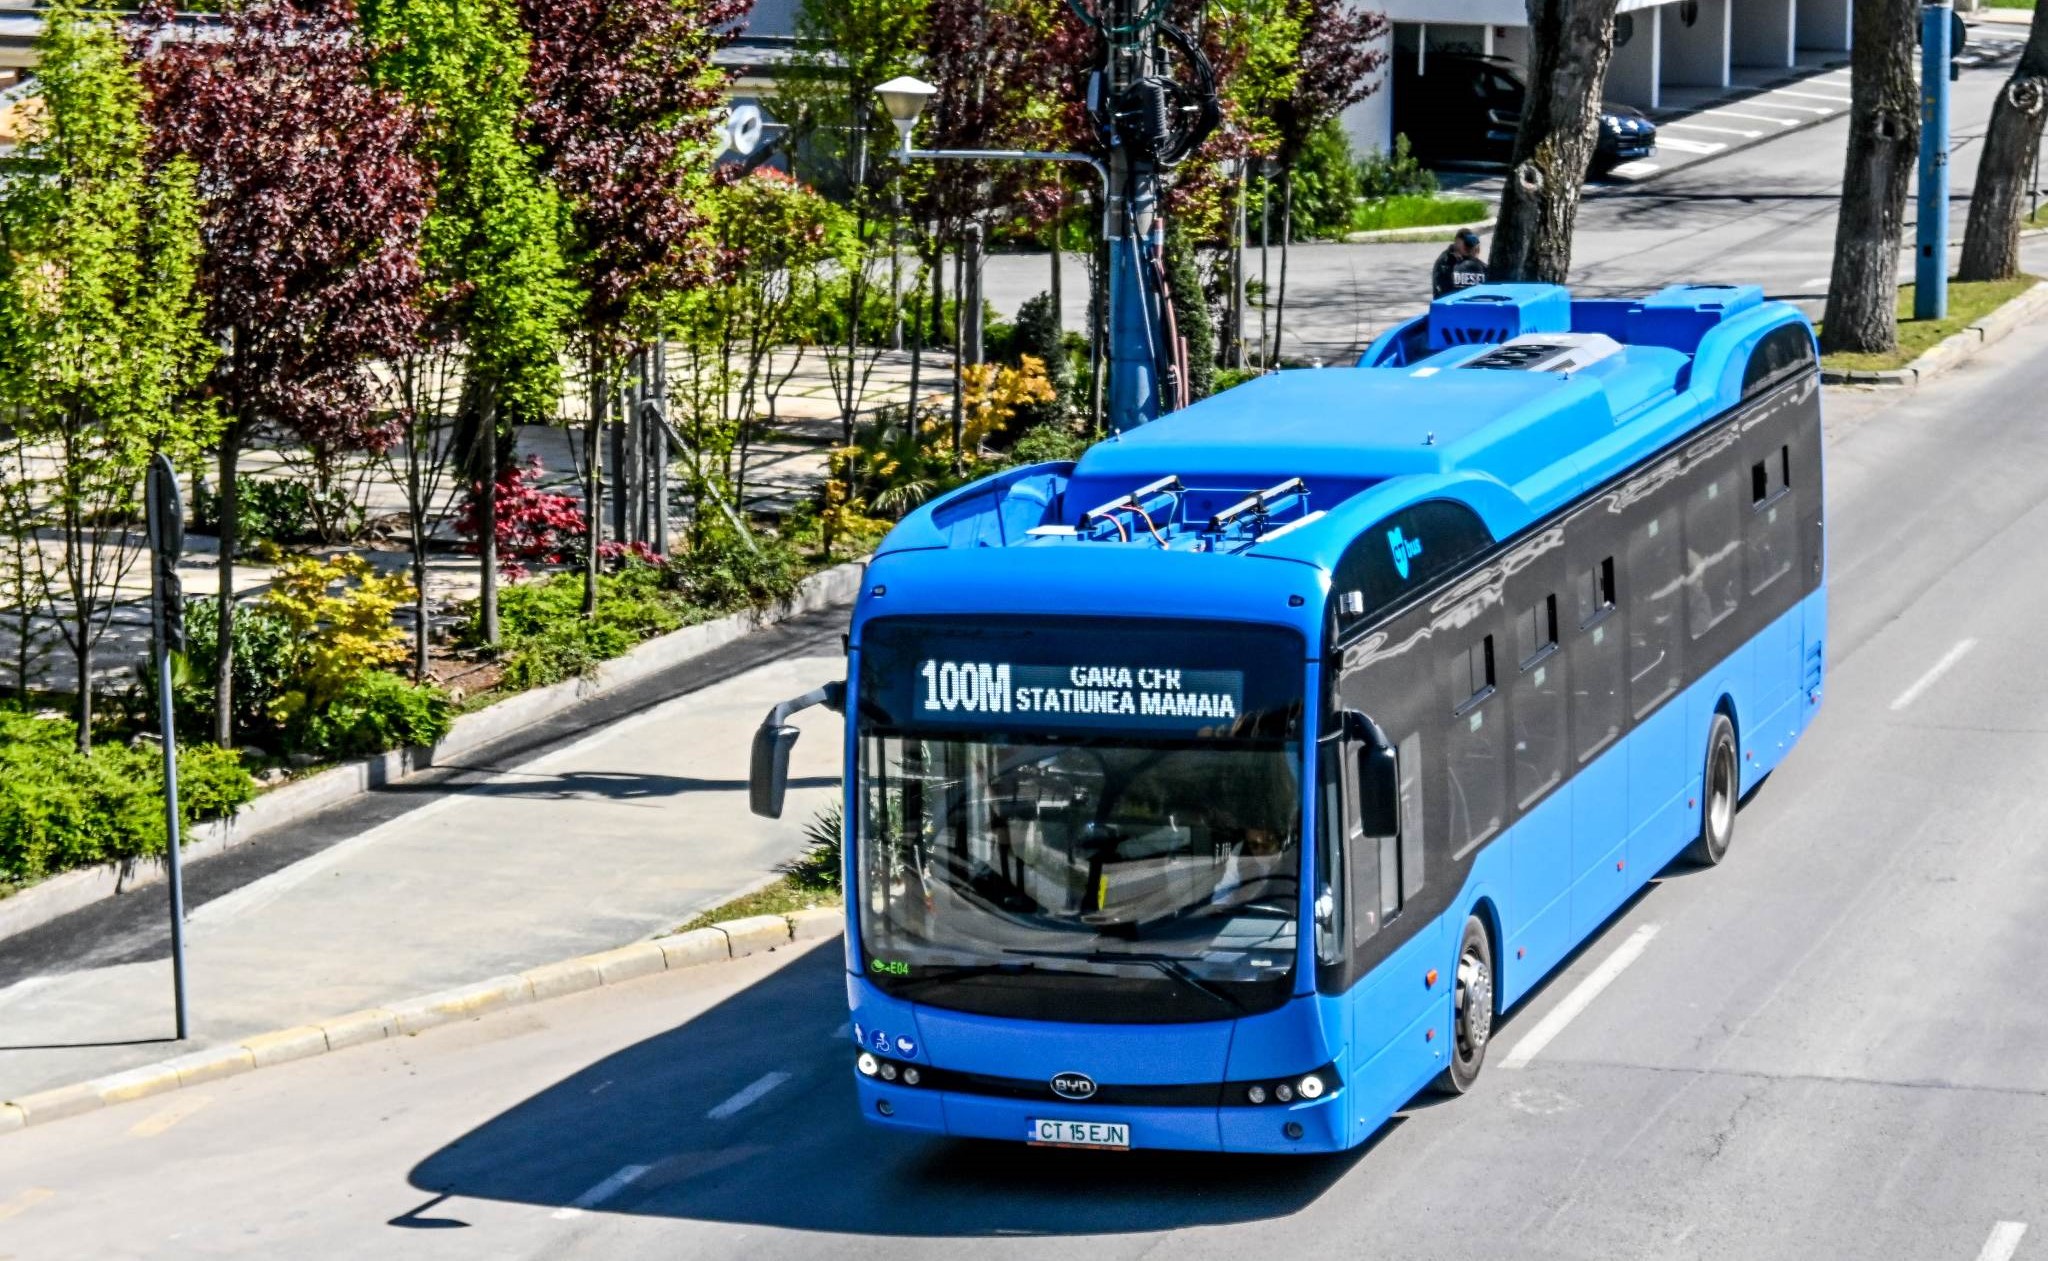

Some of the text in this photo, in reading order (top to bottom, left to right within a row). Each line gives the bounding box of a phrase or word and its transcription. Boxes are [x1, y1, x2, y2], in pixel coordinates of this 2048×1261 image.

[922, 659, 1011, 713] 100M
[1016, 687, 1235, 717] STATIUNEA MAMAIA
[1055, 1079, 1091, 1092] BYD
[1041, 1123, 1062, 1139] CT
[1069, 1124, 1085, 1141] 15
[1089, 1125, 1123, 1143] EJN
